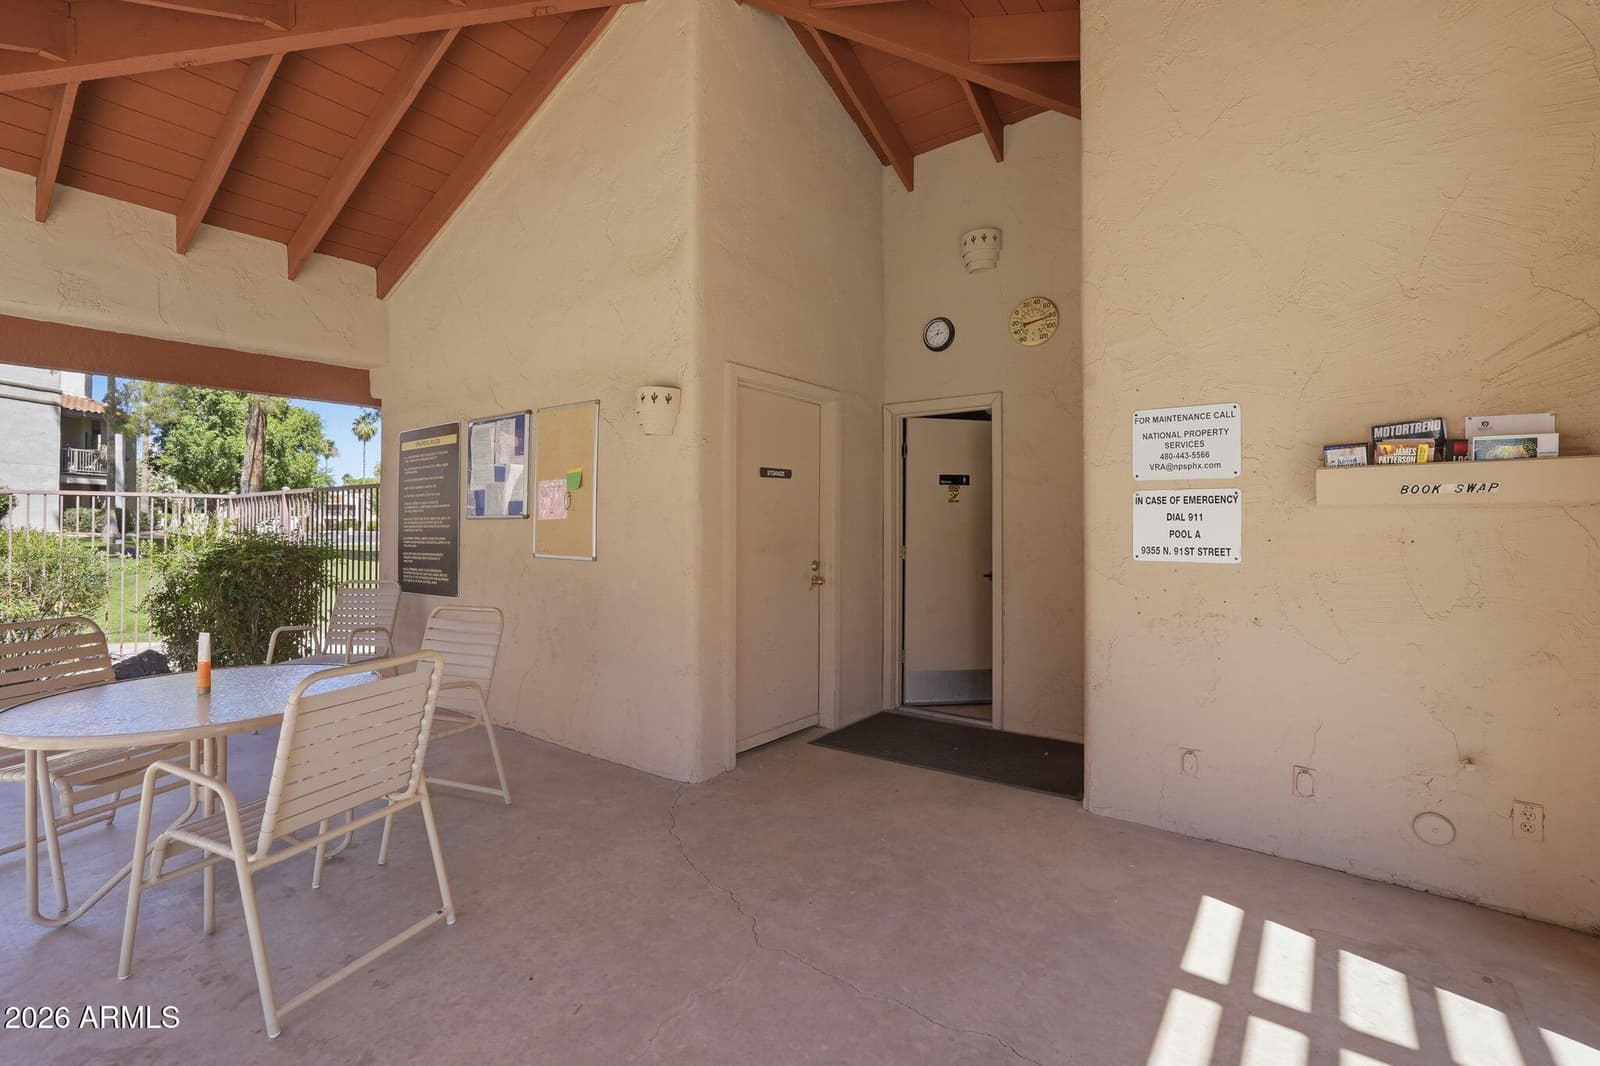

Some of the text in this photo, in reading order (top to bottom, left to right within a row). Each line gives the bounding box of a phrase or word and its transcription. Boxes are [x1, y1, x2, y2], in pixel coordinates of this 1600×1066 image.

[1134, 410, 1236, 425] FOR MAINTENANCE CALL
[1142, 428, 1230, 440] NATIONAL PROPERTY
[1374, 420, 1441, 439] MOTORTREND
[1164, 440, 1205, 449] SERVICES
[1159, 451, 1210, 460] 480-443-5566
[1393, 447, 1417, 456] JAMES
[1378, 455, 1417, 465] PATTERSON
[1149, 462, 1222, 472] VRA@npsphx.com
[1400, 482, 1500, 494] BOOK SWAP
[1135, 495, 1239, 505] IN CASE OF EMERGENCY
[1166, 513, 1203, 521] DIAL 911
[1169, 530, 1201, 539] POOL A
[1141, 546, 1232, 557] 9355 N. 91ST STREET
